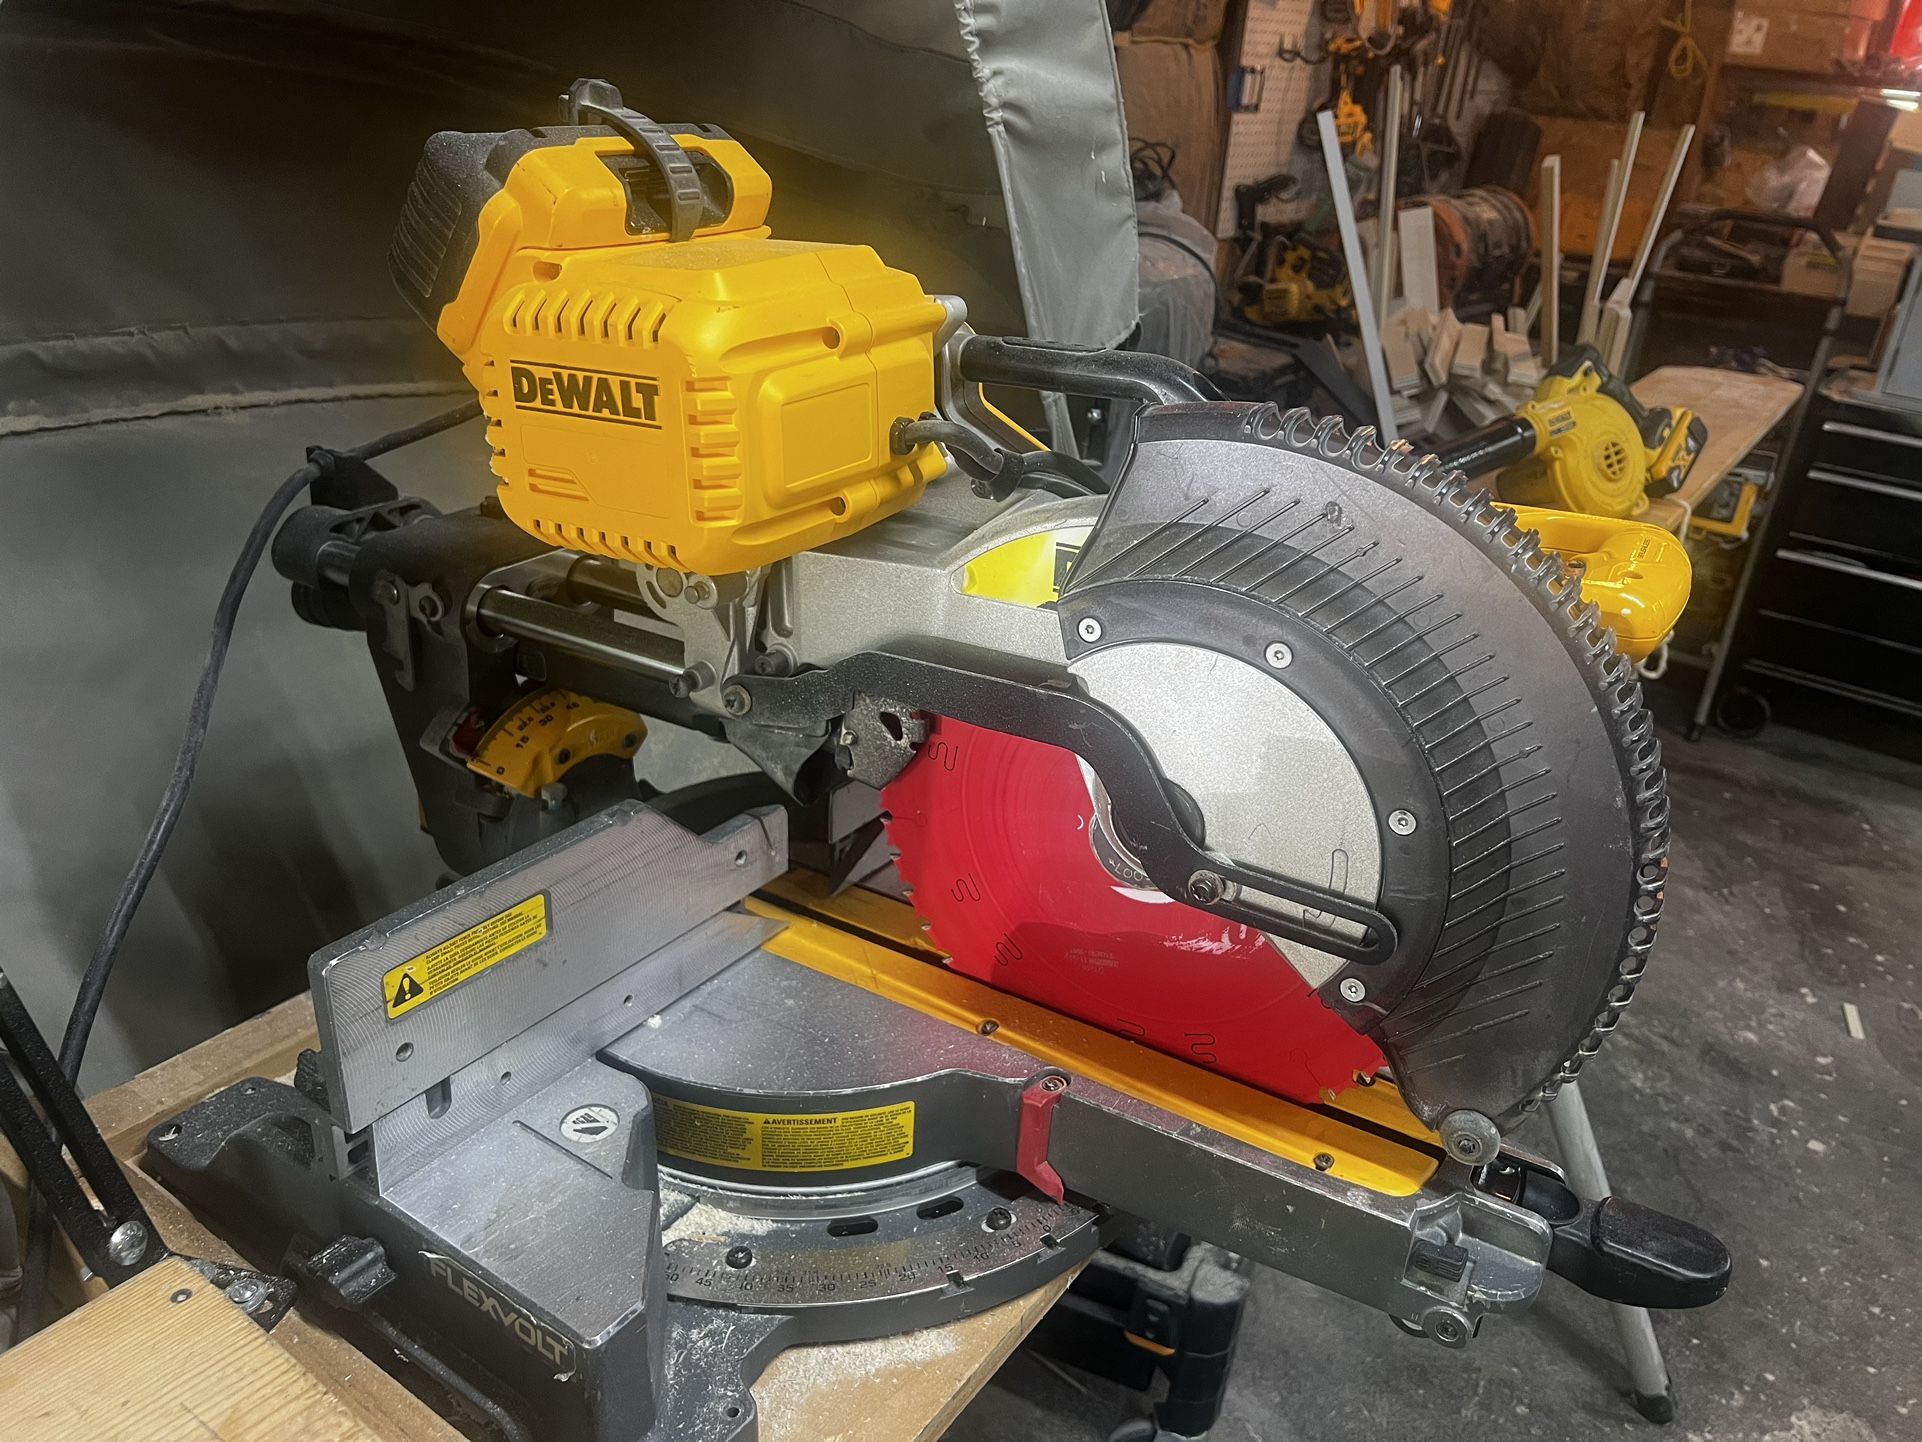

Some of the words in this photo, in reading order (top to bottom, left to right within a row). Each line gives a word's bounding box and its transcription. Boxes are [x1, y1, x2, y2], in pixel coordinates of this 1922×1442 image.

[496, 766, 505, 776] 0
[538, 714, 554, 727] 30
[772, 1117, 838, 1125] AVERTISSEMENT
[695, 1277, 712, 1287] 45
[777, 1284, 794, 1293] 35
[819, 1283, 836, 1292] 30
[860, 1279, 877, 1289] 25
[937, 1263, 954, 1273] 15
[972, 1252, 990, 1262] 10
[1042, 1224, 1052, 1232] 0
[430, 1257, 569, 1366] FLEXVOLT
